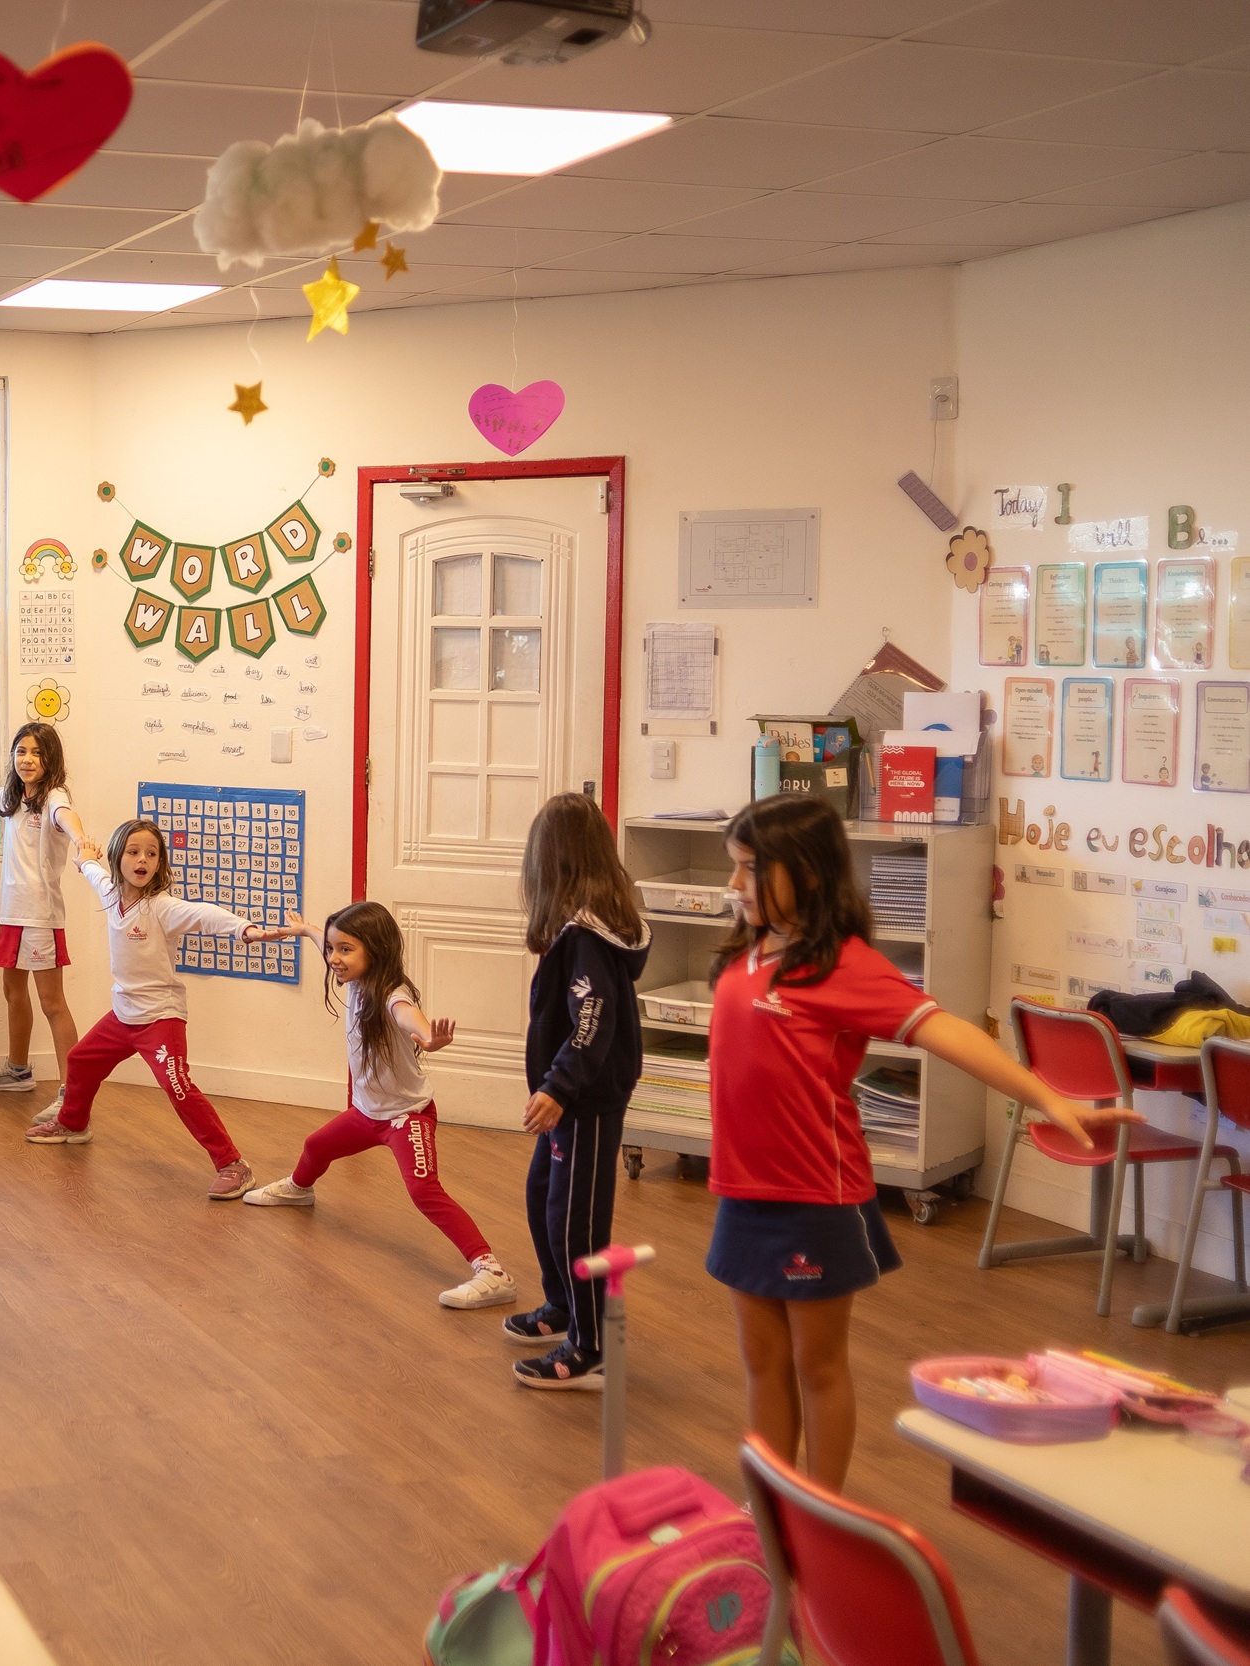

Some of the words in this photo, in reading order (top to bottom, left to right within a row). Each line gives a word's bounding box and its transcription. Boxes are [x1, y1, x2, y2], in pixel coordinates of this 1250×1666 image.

[994, 488, 1043, 527] Today
[1054, 483, 1070, 524] I
[130, 519, 307, 584] WORD
[134, 594, 312, 643] WALL
[276, 666, 287, 675] the
[143, 684, 170, 696] beautiful
[181, 688, 208, 697] delicious
[295, 705, 309, 717] girl
[182, 721, 215, 733] amphibian
[232, 719, 249, 729] bird
[222, 743, 242, 753] insect
[287, 827, 296, 835] 20
[999, 797, 1070, 851] Hoje
[1087, 827, 1119, 852] eu
[221, 891, 230, 899] 56
[1155, 885, 1177, 894] Corajoso
[571, 997, 595, 1048] Canadian
[583, 1025, 597, 1046] School
[166, 1056, 186, 1100] Canadian
[408, 1120, 428, 1178] Canadian
[426, 1148, 434, 1171] School
[708, 1592, 742, 1633] UP
